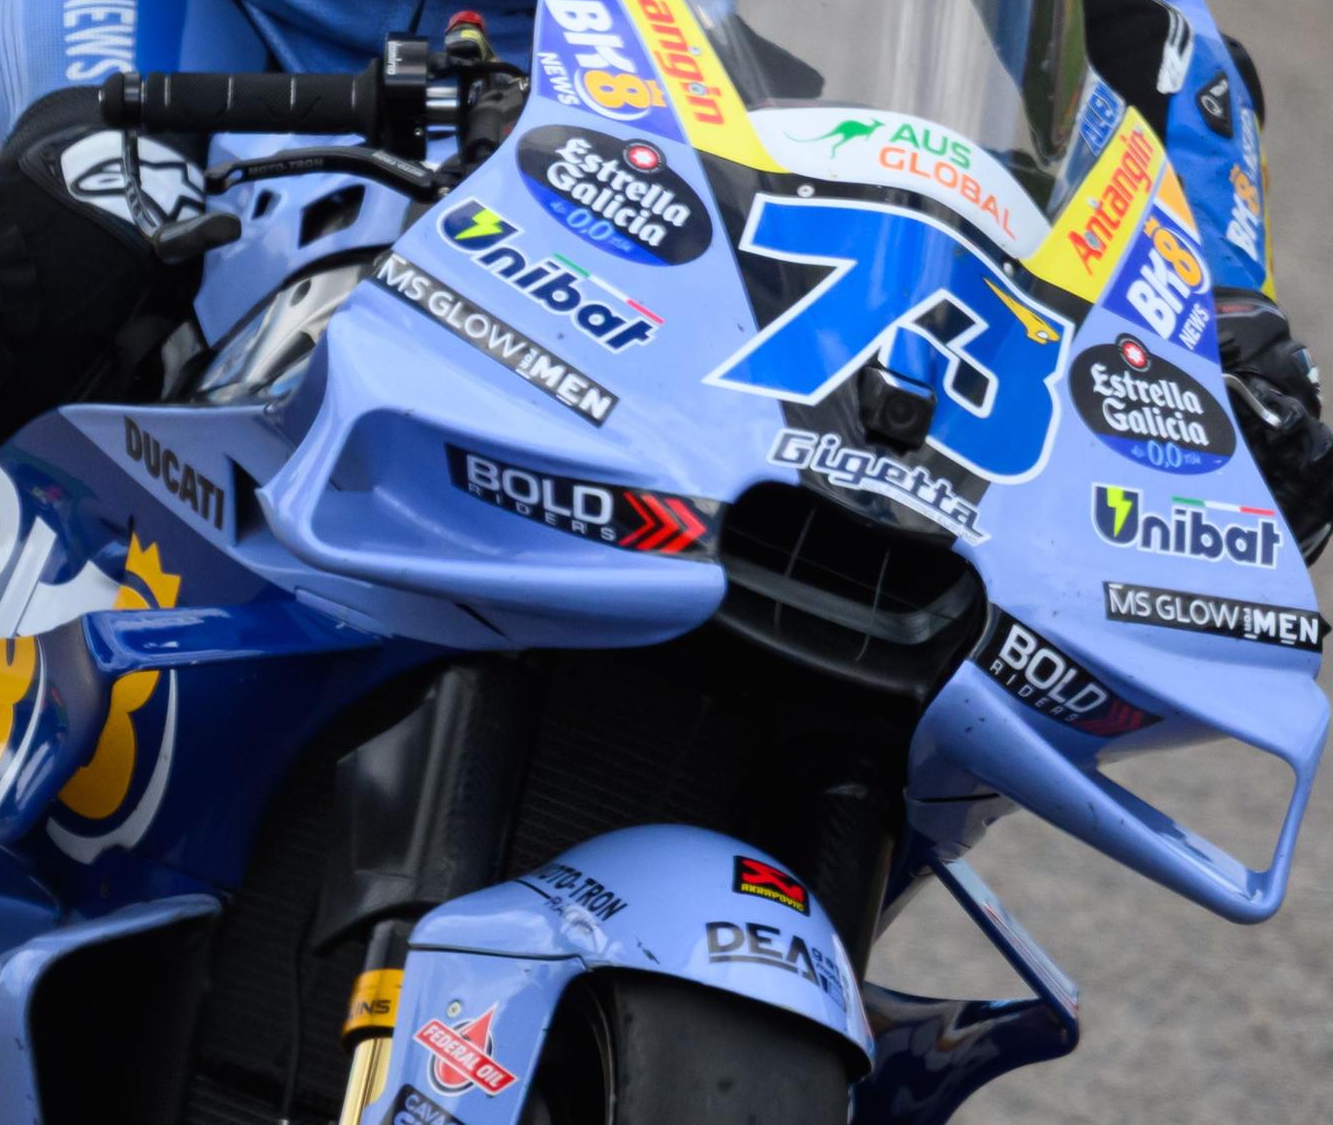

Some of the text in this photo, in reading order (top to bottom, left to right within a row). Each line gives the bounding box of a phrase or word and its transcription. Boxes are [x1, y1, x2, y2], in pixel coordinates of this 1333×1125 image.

[537, 50, 580, 107] NEWS
[555, 137, 691, 227] Estrella
[889, 123, 972, 169] AUS
[546, 161, 667, 247] Galicia
[878, 146, 1018, 241] GLOBAL
[1066, 131, 1156, 275] Antangin
[438, 197, 666, 354] Unibat
[1126, 226, 1205, 340] BK8
[378, 257, 430, 302] MS
[428, 291, 524, 360] GLOW
[532, 352, 614, 420] MEN
[1179, 303, 1211, 353] NEWS
[1090, 362, 1204, 415] Estrella
[1102, 396, 1210, 447] Galicia
[124, 415, 226, 532] DUCATI
[466, 453, 614, 525] BOLD
[468, 482, 617, 542] RIDERS
[769, 429, 990, 542] Gigetta
[1093, 483, 1282, 568] Unibat
[1109, 585, 1151, 616] MS
[1155, 598, 1240, 631] GLOW
[1252, 608, 1320, 645] MEN
[990, 659, 1079, 723] RIDERS
[999, 623, 1109, 714] BOLD
[538, 863, 627, 922] OTO-TRON
[421, 1024, 504, 1087] FEDERAL OIL
